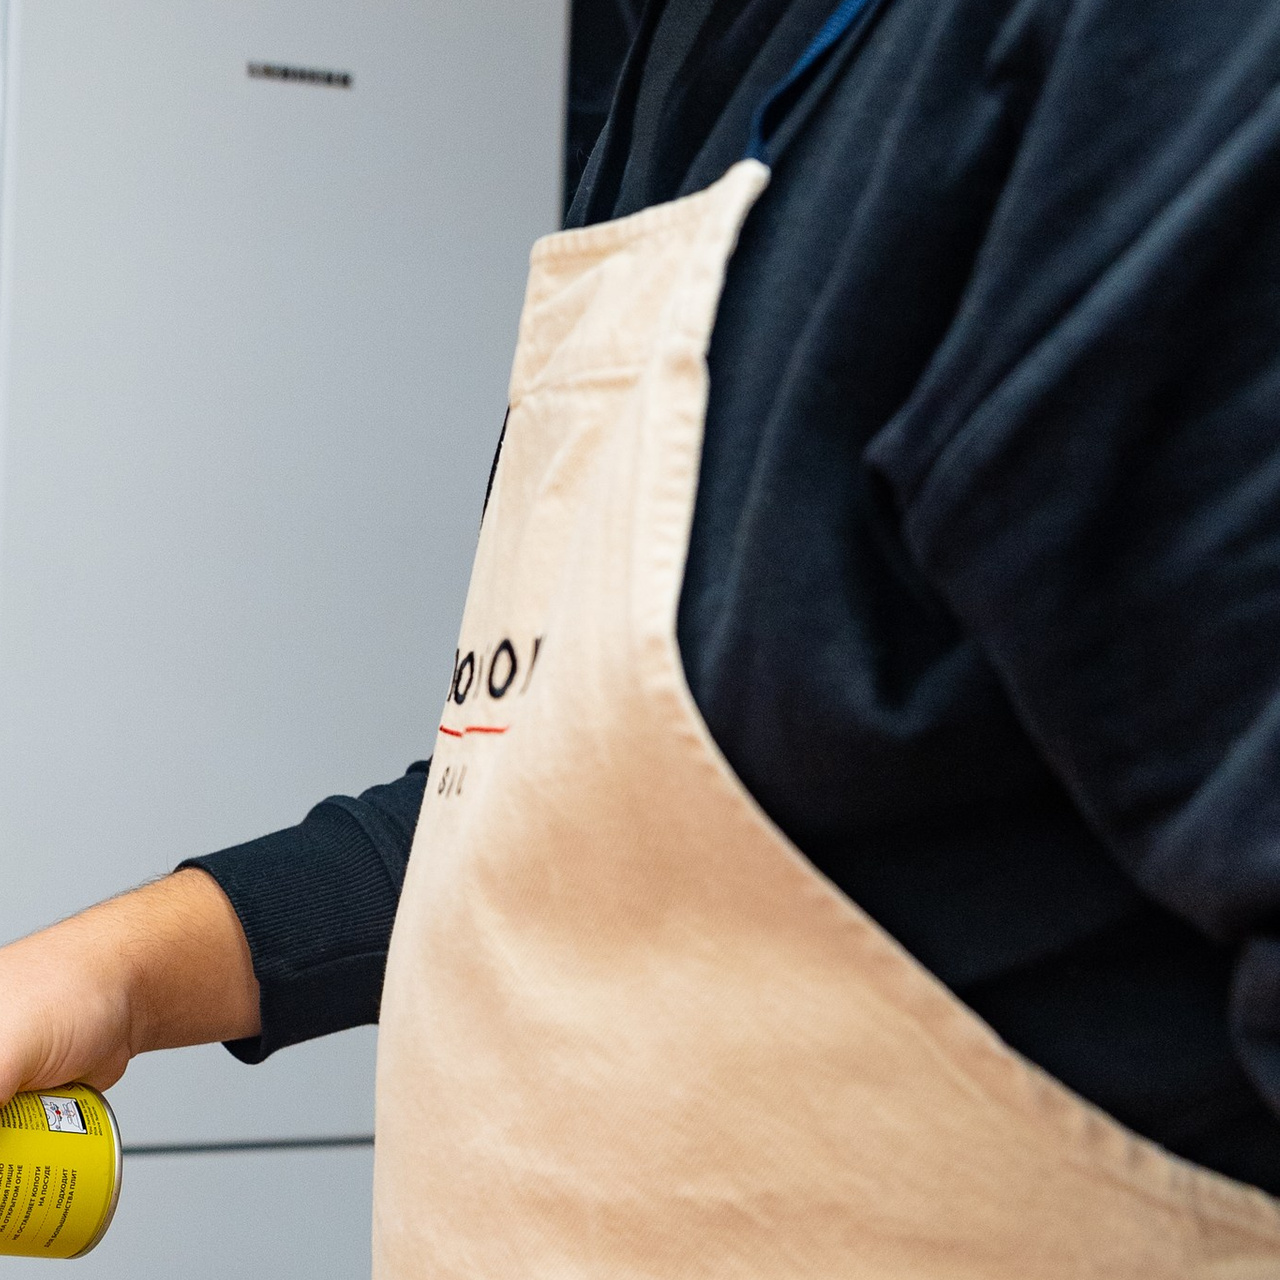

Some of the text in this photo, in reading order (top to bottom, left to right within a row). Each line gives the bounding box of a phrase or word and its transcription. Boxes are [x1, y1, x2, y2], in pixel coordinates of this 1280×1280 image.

[4, 1185, 21, 1224] ОТКРЫТОМ
[15, 1164, 23, 1185] ОГНЕ
[5, 1164, 14, 1188] ПИЩИ
[38, 1165, 51, 1207] НА ПОСУДЕ
[56, 1168, 68, 1209] ПОДХОДИТ
[12, 1166, 41, 1241] НЕ ОСТАВЛЯЕТ КОПОТИ
[51, 1190, 75, 1240] БОЛЬШИНСТВА
[69, 1169, 78, 1190] ПЛИТ
